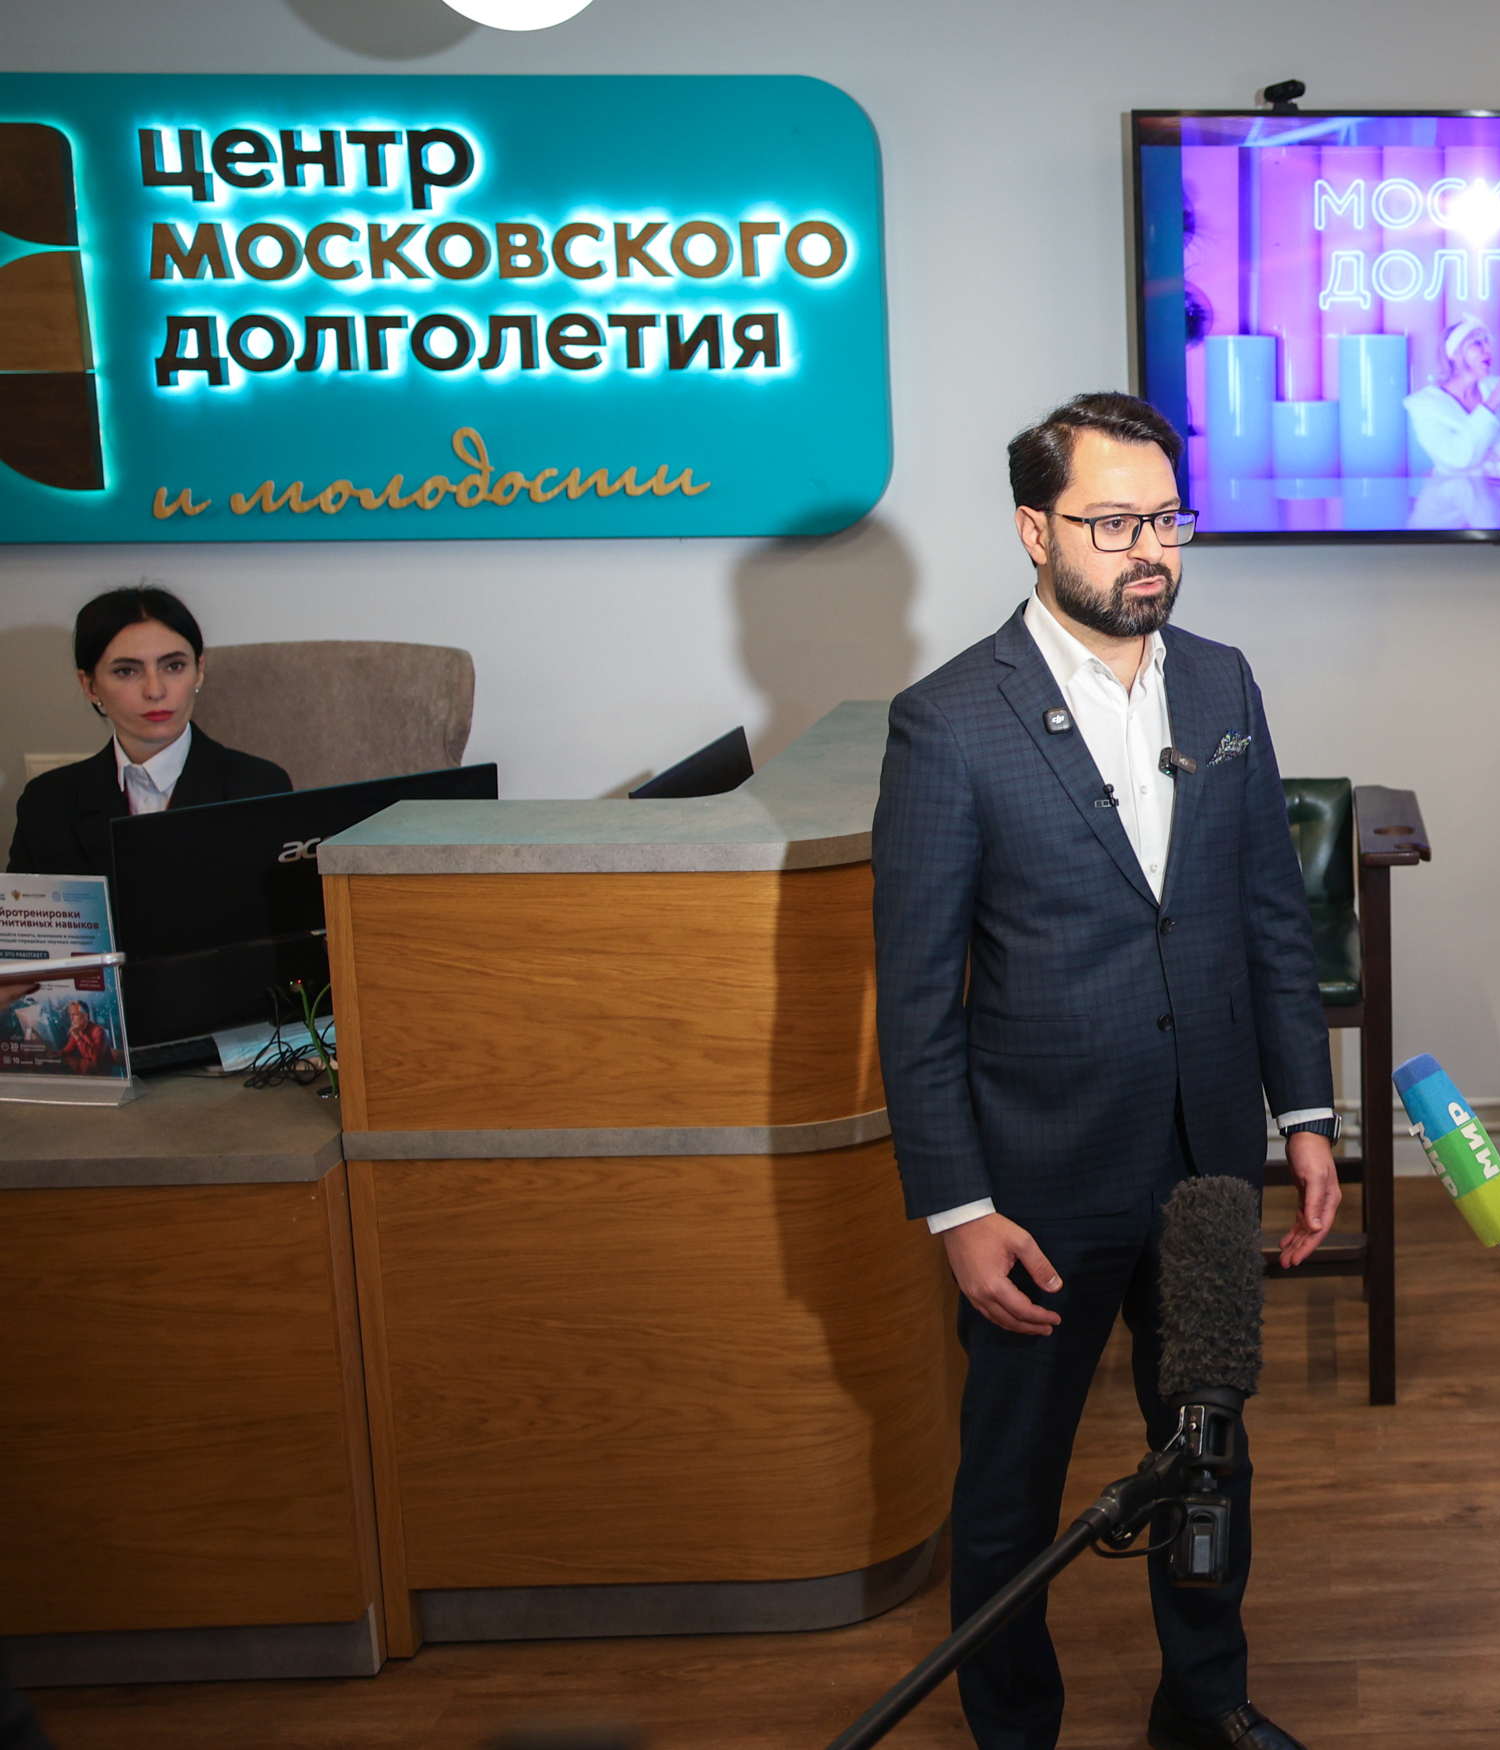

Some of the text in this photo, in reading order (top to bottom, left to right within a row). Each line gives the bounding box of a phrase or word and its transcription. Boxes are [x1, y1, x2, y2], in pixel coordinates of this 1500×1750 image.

[138, 127, 476, 210] центр
[150, 219, 850, 281] московского
[155, 313, 783, 387] долголетия
[153, 426, 712, 520] и молодости
[278, 836, 331, 863] ac
[0, 919, 99, 930] нитивных навыков
[1447, 1101, 1500, 1180] МИР
